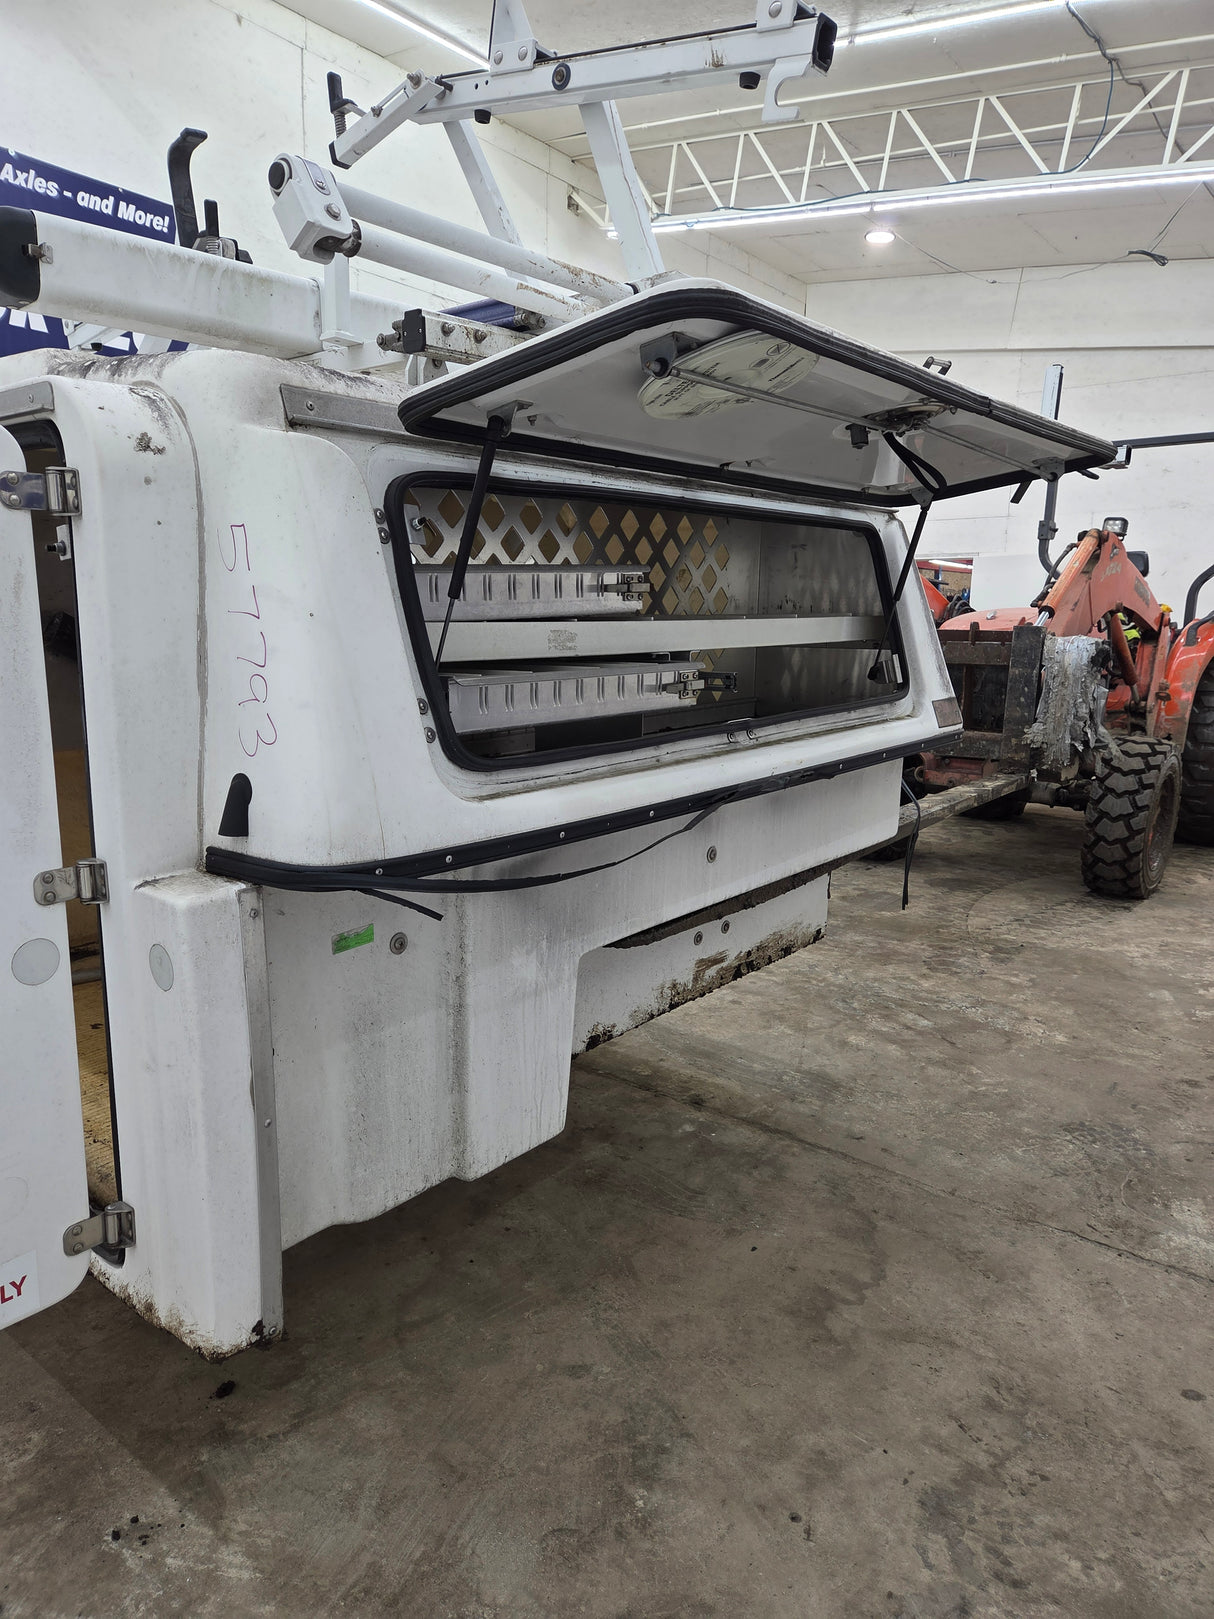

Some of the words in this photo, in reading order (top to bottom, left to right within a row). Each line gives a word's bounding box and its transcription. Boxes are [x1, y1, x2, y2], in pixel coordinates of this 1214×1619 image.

[0, 163, 59, 198] Axles
[77, 190, 115, 215] and
[118, 200, 170, 233] More!
[216, 523, 278, 757] 57793
